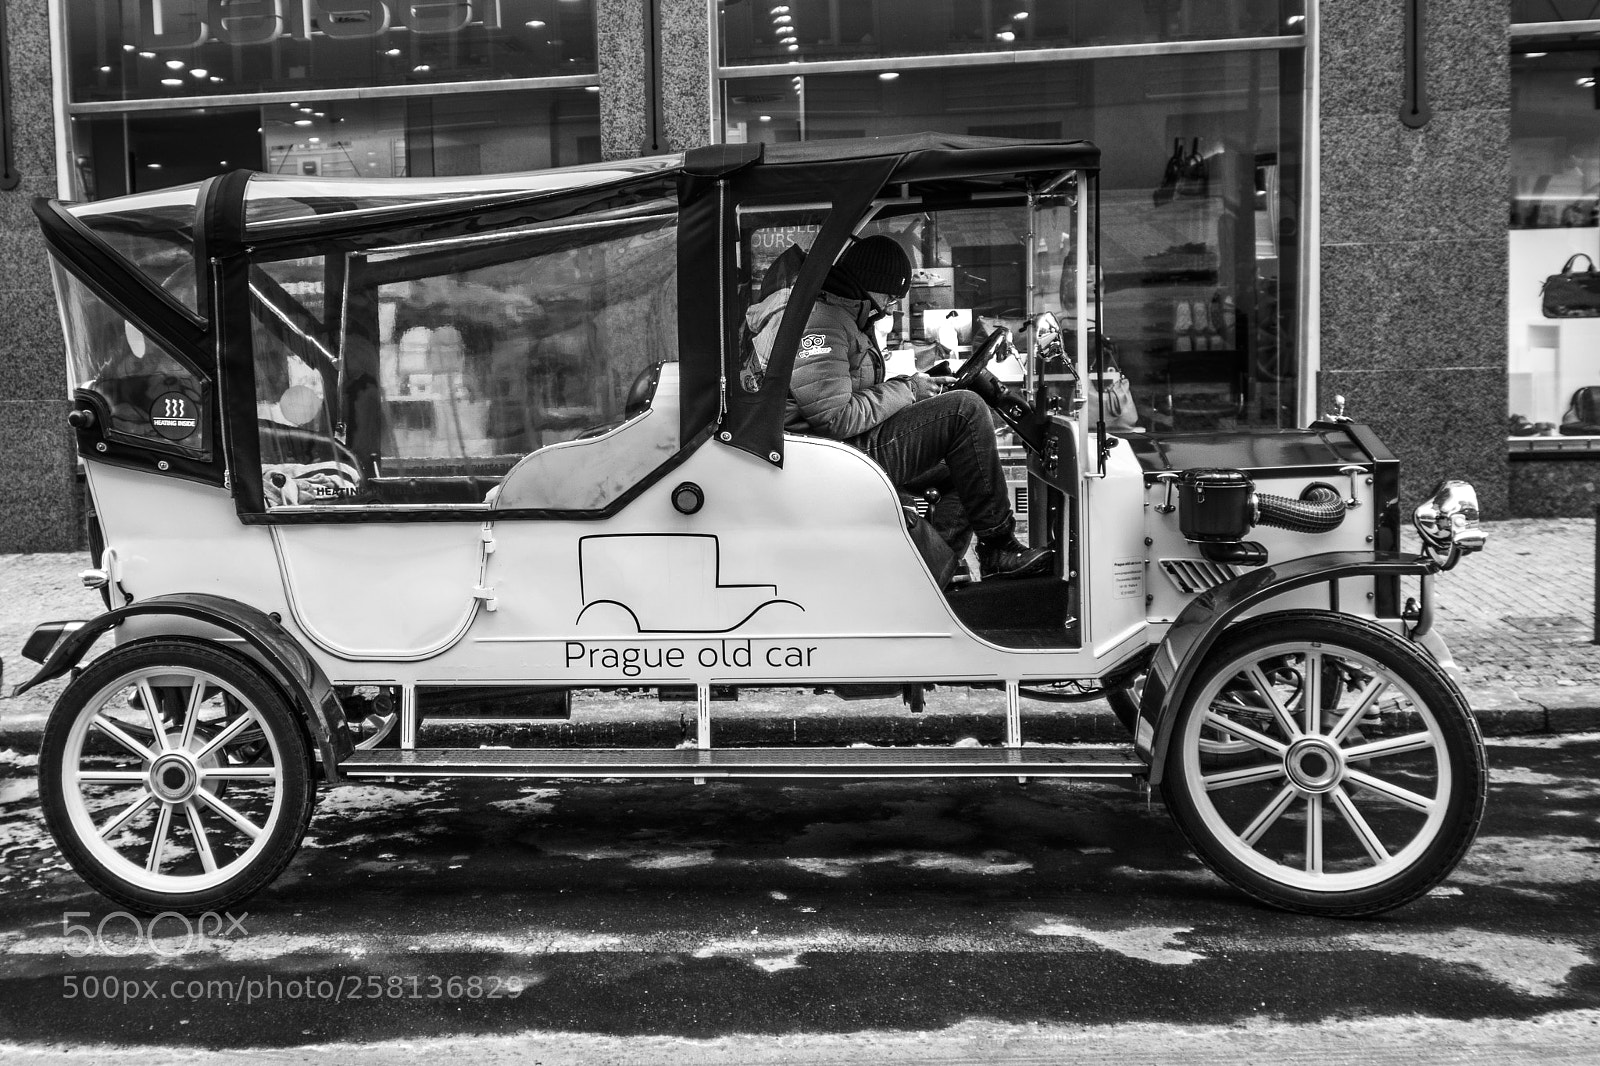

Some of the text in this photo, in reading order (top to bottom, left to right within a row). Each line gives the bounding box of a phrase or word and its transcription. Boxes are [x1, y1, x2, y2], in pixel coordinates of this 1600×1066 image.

[565, 639, 817, 676] Prague old car
